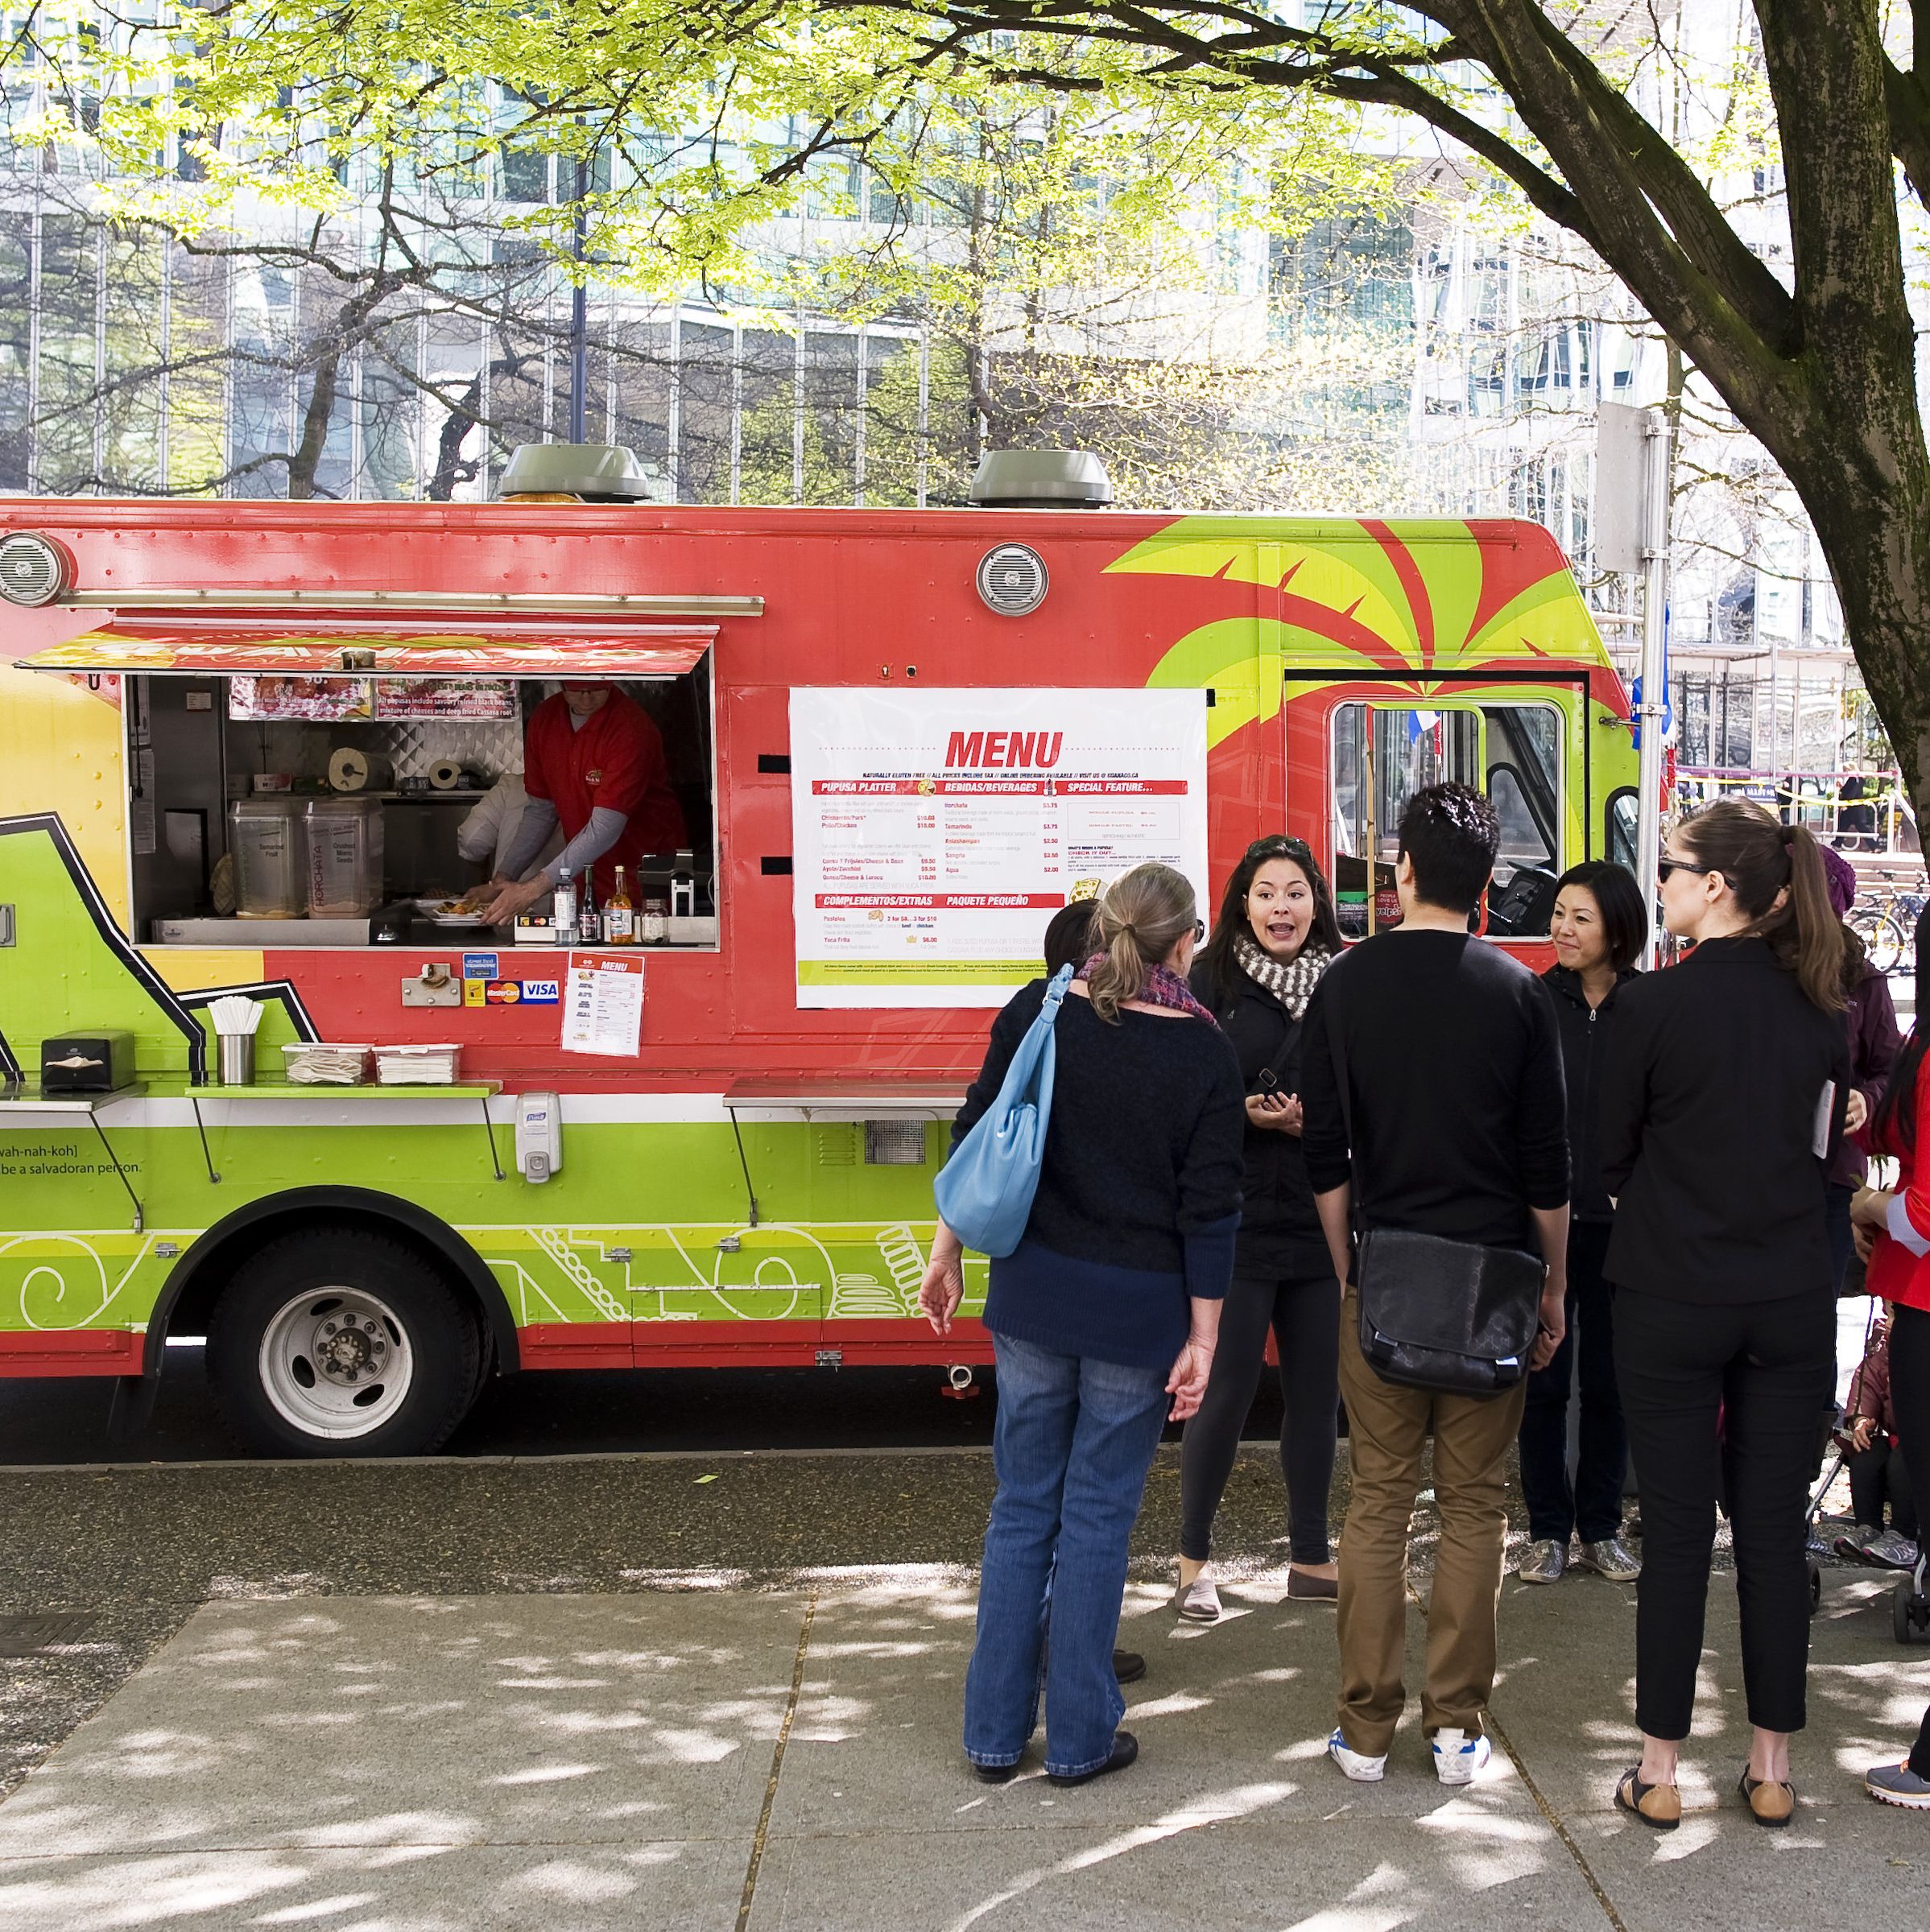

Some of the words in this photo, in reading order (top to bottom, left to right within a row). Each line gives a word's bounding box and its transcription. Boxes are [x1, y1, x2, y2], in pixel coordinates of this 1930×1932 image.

[456, 658, 616, 667] CUISINE
[446, 708, 461, 716] deep
[945, 732, 1063, 768] MENU
[821, 782, 857, 792] PUPUSA
[858, 782, 897, 792] PLATTER
[944, 782, 1037, 792] BEBIDAS/BEVERAGES
[1067, 782, 1103, 792] SPECIAL
[1105, 782, 1153, 792] FEATURE...
[313, 845, 324, 907] HORCHATA
[823, 896, 933, 906] COMPLEMENTOS/EXTRAS
[946, 896, 986, 906] PAQUETE
[987, 894, 1029, 906] PEQUEÑO
[1376, 907, 1394, 917] yelp
[601, 960, 628, 972] MENU
[527, 984, 557, 996] VISA
[1, 1163, 17, 1174] be
[19, 1166, 27, 1174] a
[29, 1163, 94, 1174] salvadoran
